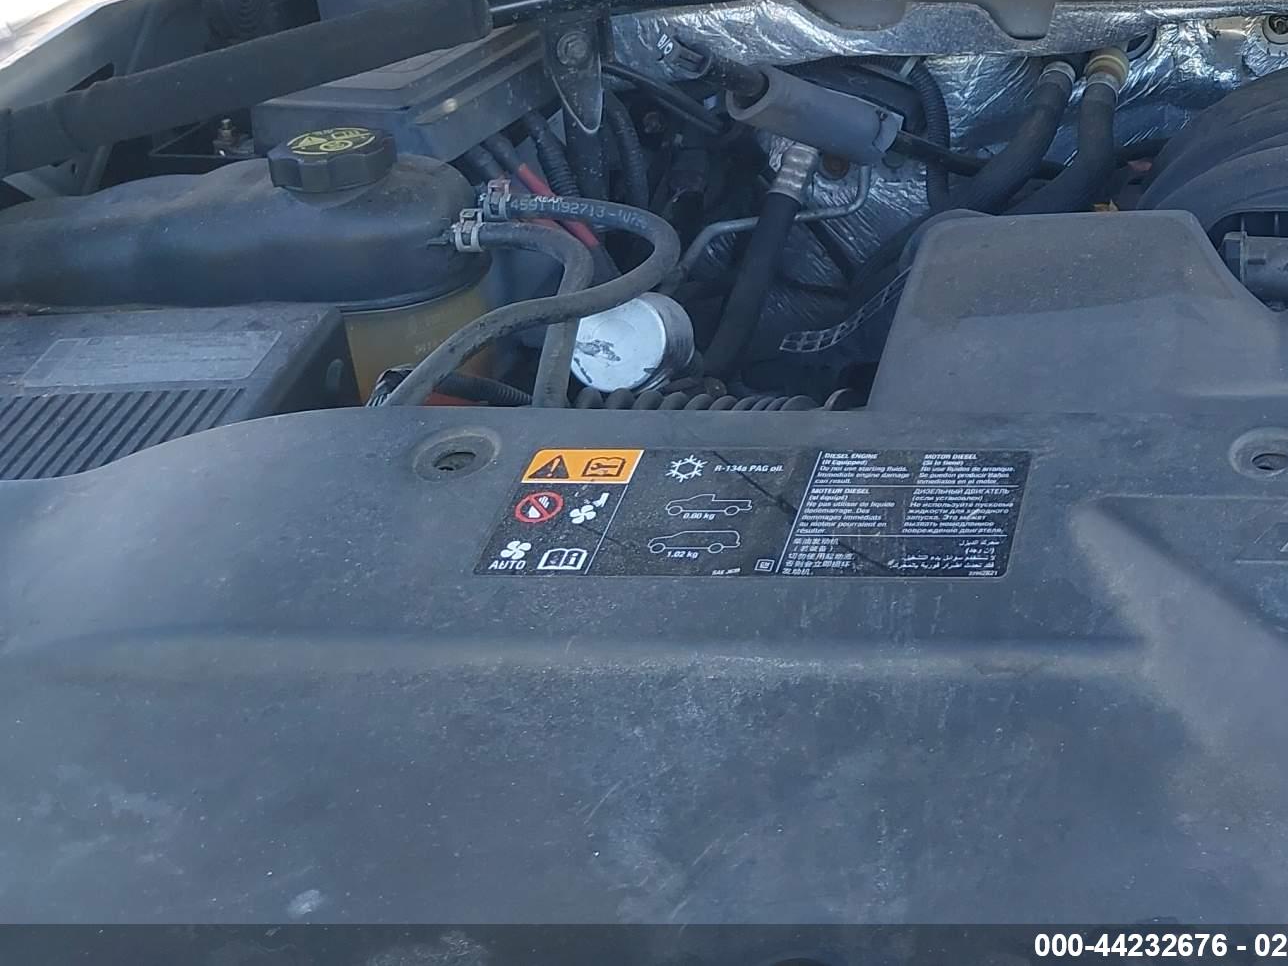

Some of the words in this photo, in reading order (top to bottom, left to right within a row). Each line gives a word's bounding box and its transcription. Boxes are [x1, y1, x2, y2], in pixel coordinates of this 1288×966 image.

[714, 464, 749, 472] R-134a
[749, 464, 770, 472] PAG
[487, 559, 527, 570] AUTO
